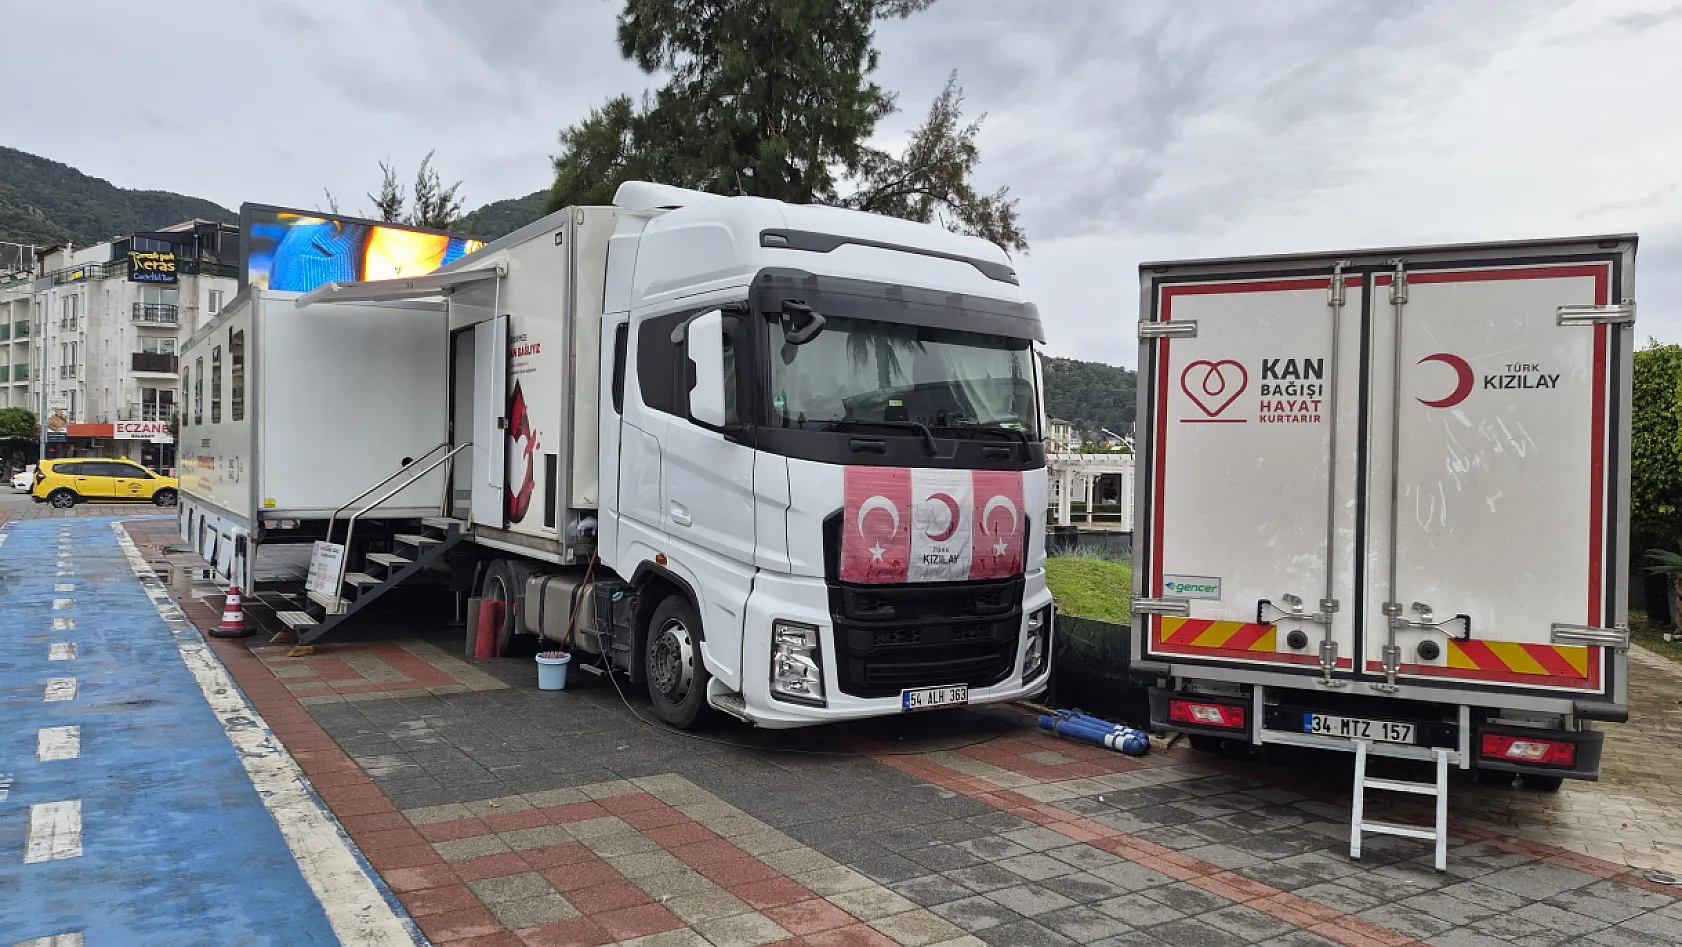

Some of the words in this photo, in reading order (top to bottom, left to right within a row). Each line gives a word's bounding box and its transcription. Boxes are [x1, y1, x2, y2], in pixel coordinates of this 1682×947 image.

[1261, 358, 1324, 380] KAN
[1505, 362, 1540, 373] TÜRK
[1483, 373, 1561, 390] KIZILAY
[1260, 380, 1323, 400] BAĞIŞI
[1260, 399, 1322, 413] HAYAT
[1259, 413, 1321, 424] KURTARIR
[116, 423, 168, 433] ECZANE
[923, 554, 959, 565] KIZILAY
[1175, 583, 1218, 593] gencer
[910, 692, 922, 706] 54
[927, 690, 944, 705] ALH
[949, 688, 966, 702] 363
[1311, 716, 1331, 734] 34
[1340, 718, 1371, 738] MTZ
[1382, 722, 1411, 742] 157
